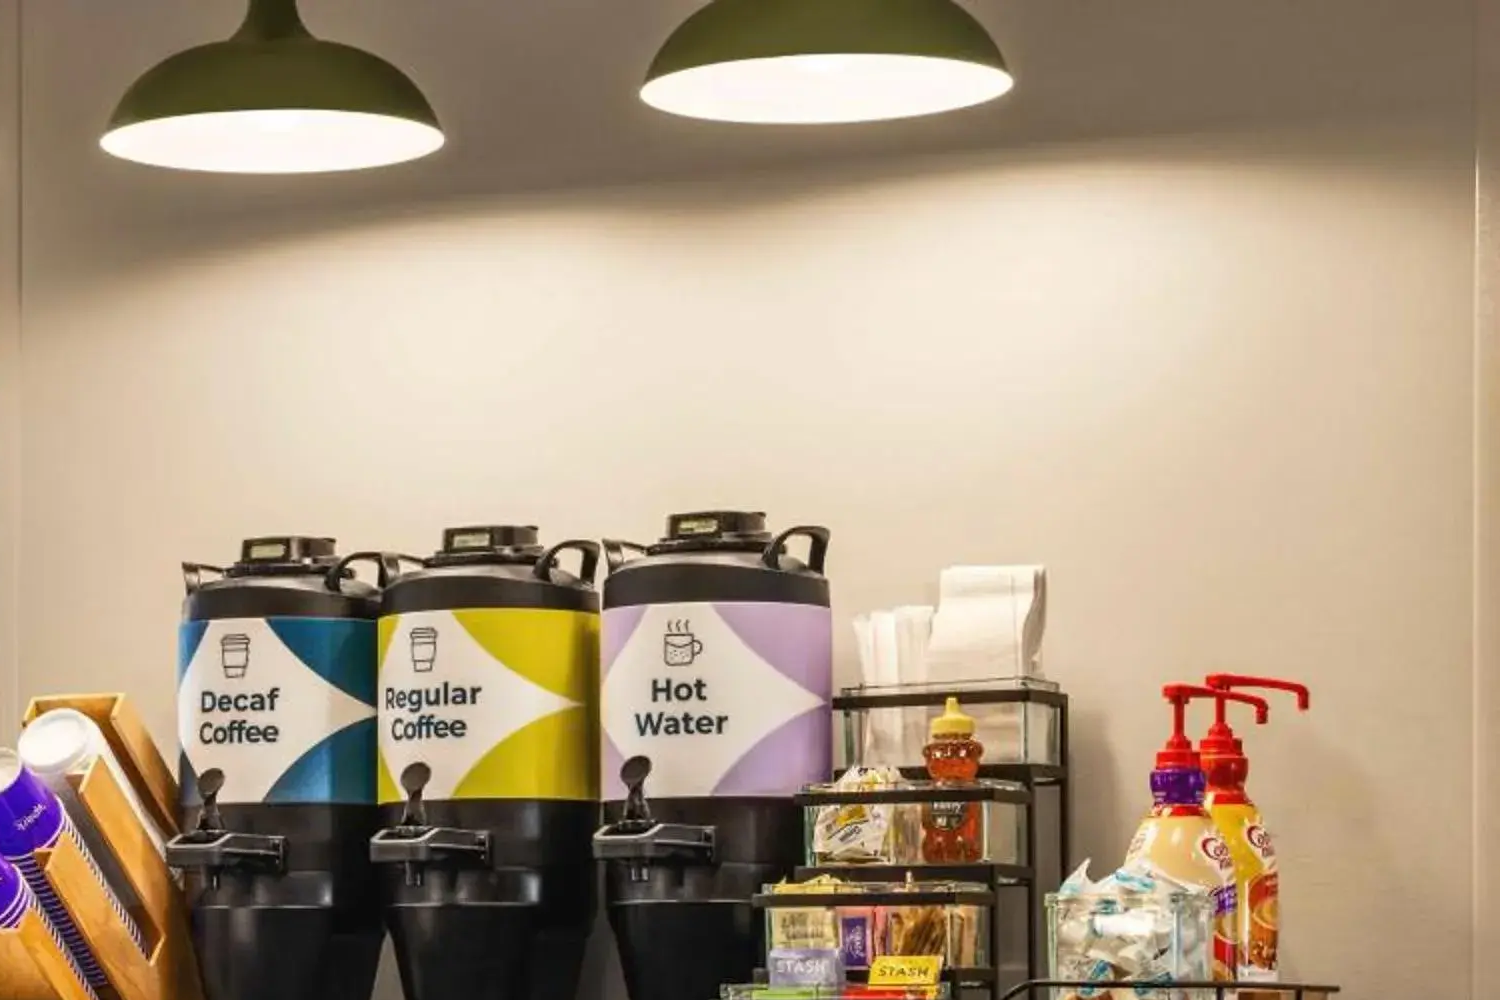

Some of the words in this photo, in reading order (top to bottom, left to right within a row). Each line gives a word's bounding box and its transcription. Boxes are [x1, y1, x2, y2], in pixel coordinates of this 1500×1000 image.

[201, 687, 280, 713] Decaf
[385, 681, 482, 713] Regular
[651, 677, 707, 703] Hot
[199, 719, 279, 745] Coffee
[391, 714, 468, 741] Coffee
[634, 711, 729, 737] Water
[776, 958, 828, 975] STASH
[877, 965, 930, 978] STASH
